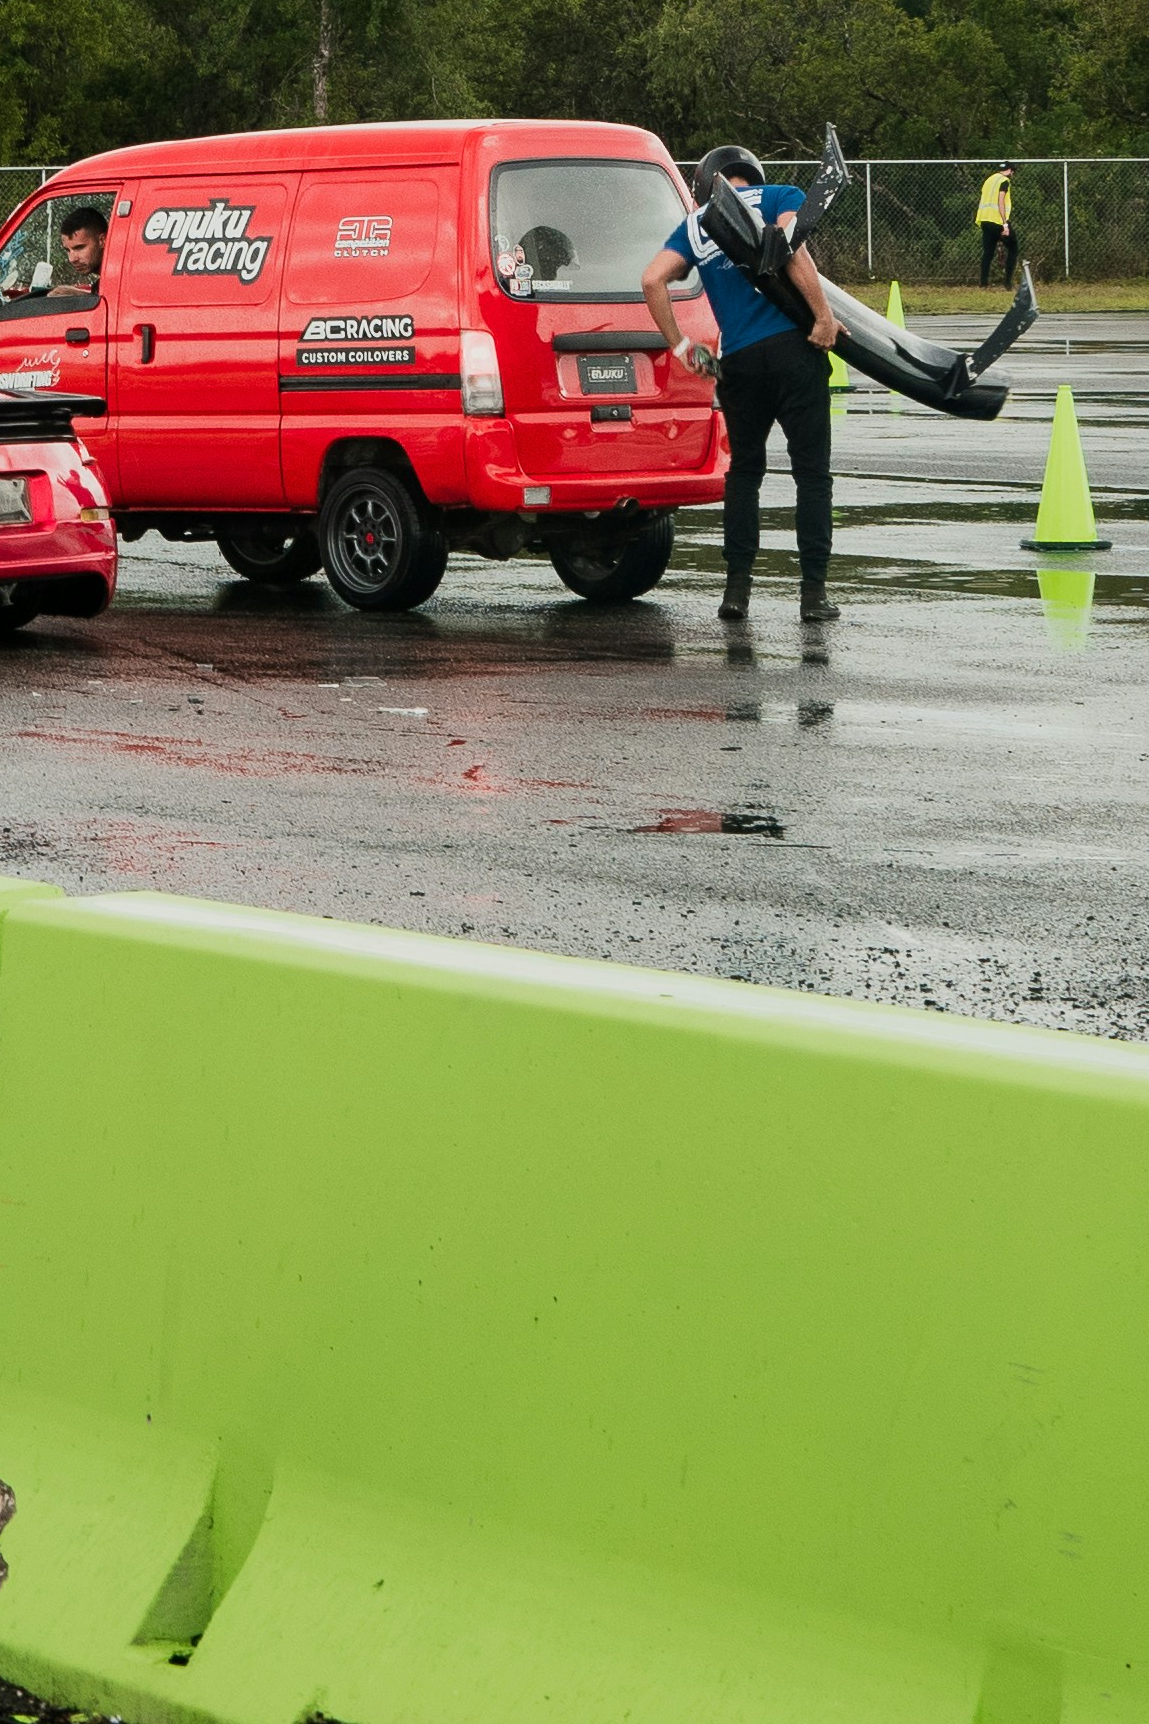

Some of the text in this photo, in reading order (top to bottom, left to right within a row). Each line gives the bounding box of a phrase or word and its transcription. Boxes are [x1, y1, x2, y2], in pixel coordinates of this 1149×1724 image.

[144, 202, 252, 248] enjuku
[176, 240, 268, 280] racing
[334, 249, 389, 257] CLUTCH
[301, 349, 410, 364] CUSTOM COILOVERS
